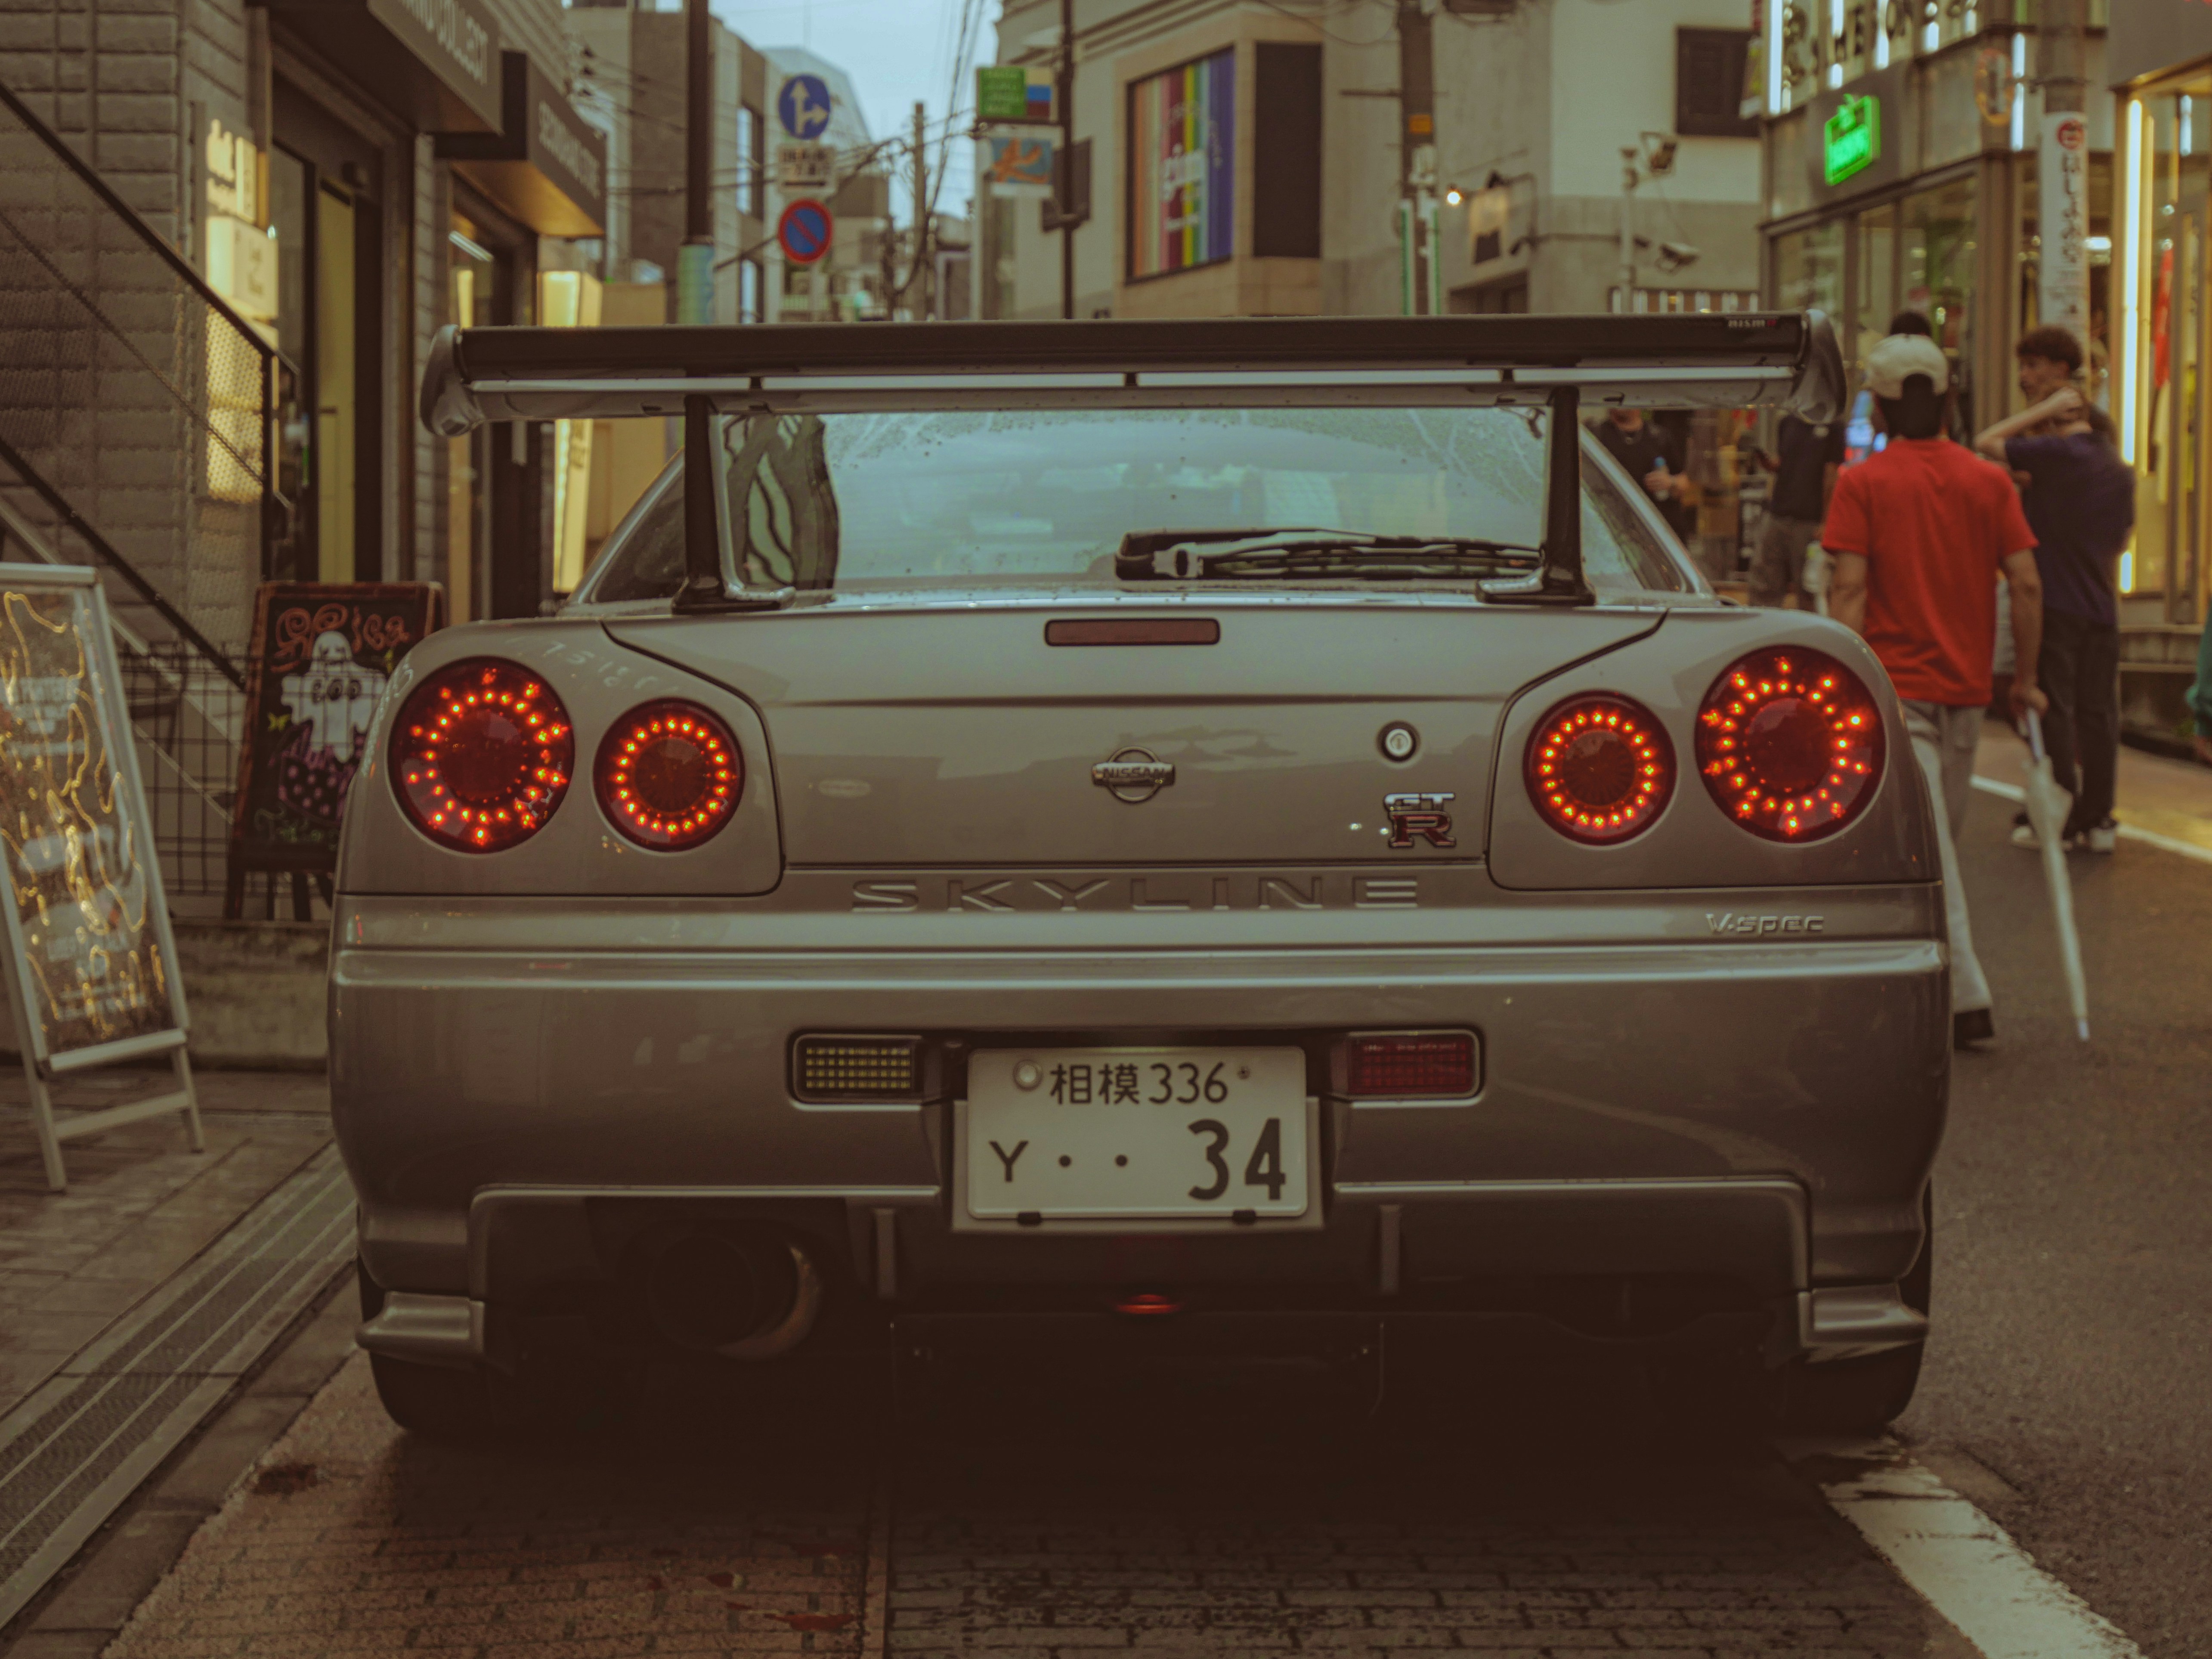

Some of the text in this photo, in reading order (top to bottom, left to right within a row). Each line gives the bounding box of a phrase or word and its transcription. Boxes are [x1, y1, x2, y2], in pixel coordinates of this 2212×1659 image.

[1102, 767, 1165, 778] NISSAN
[851, 876, 1418, 912] SKYLINE
[1188, 1117, 1287, 1201] 34
